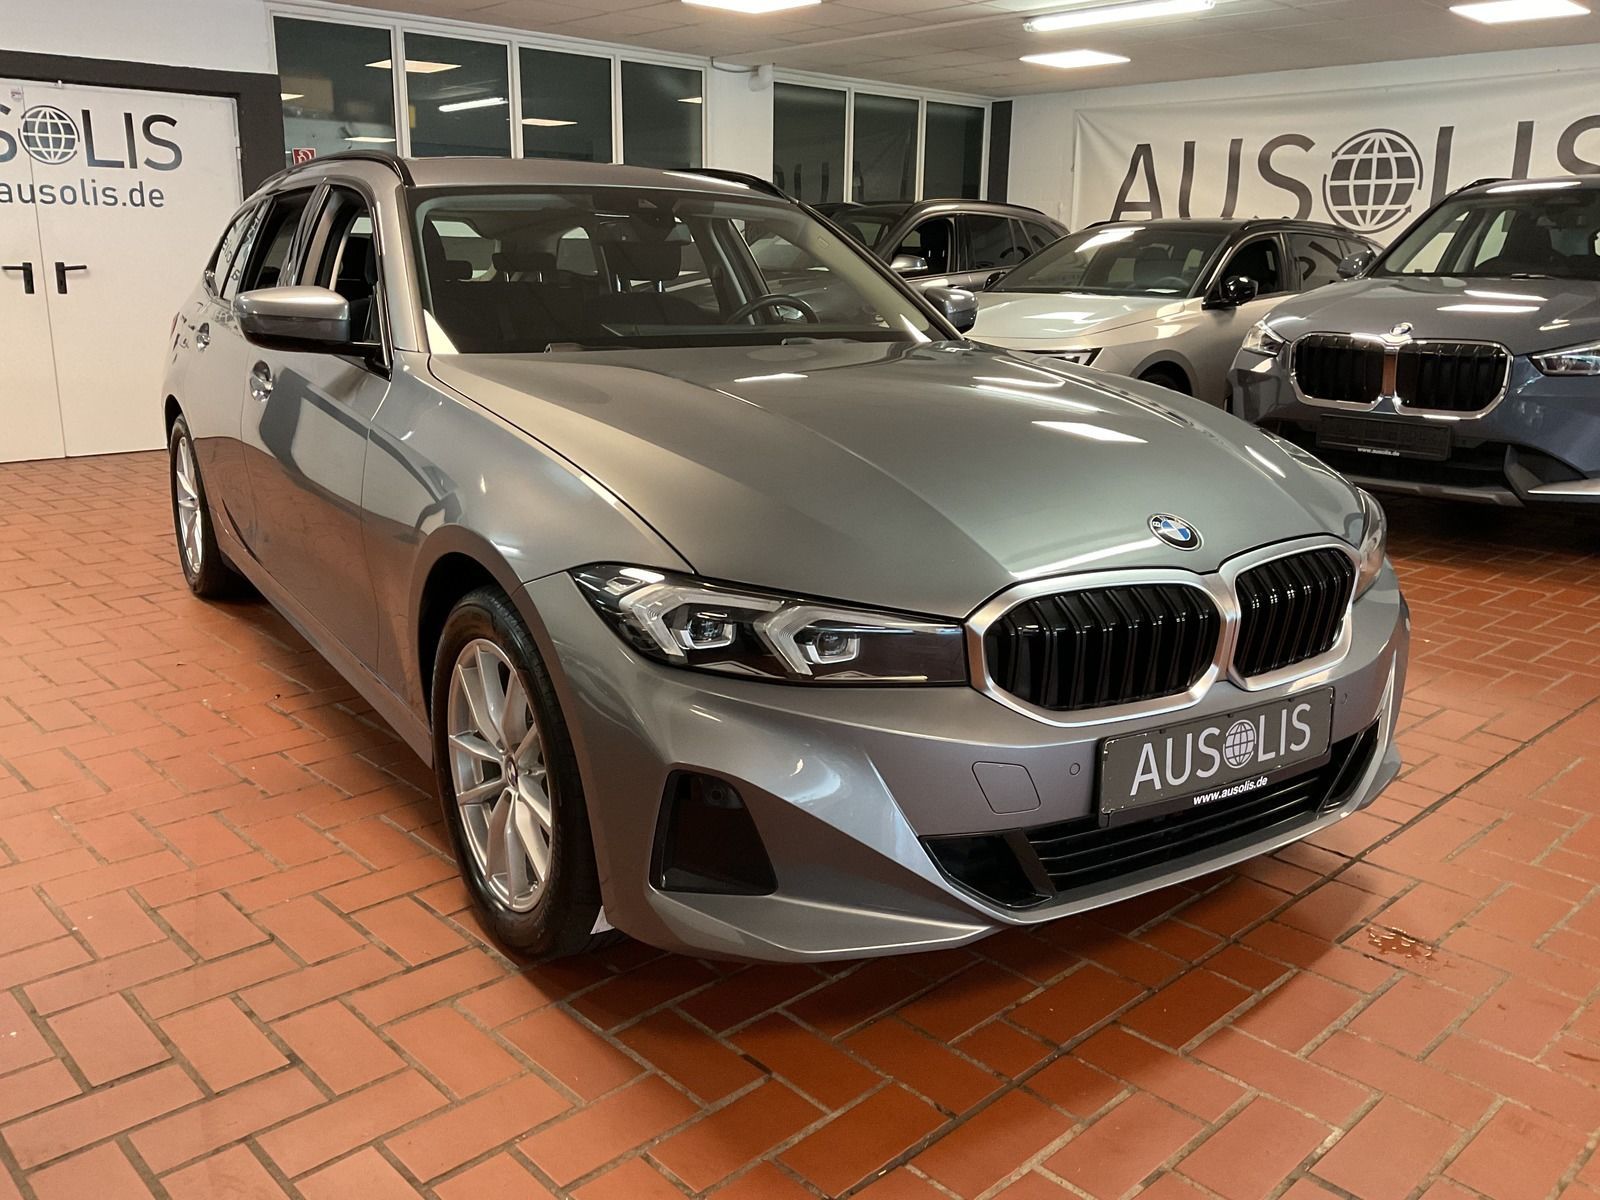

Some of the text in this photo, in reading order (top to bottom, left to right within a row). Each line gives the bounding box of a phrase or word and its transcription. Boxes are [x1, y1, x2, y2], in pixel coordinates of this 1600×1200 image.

[0, 178, 165, 208] ausolis.de
[1130, 703, 1311, 796] AUSOLIS
[1193, 776, 1268, 805] www.ausolis.de
